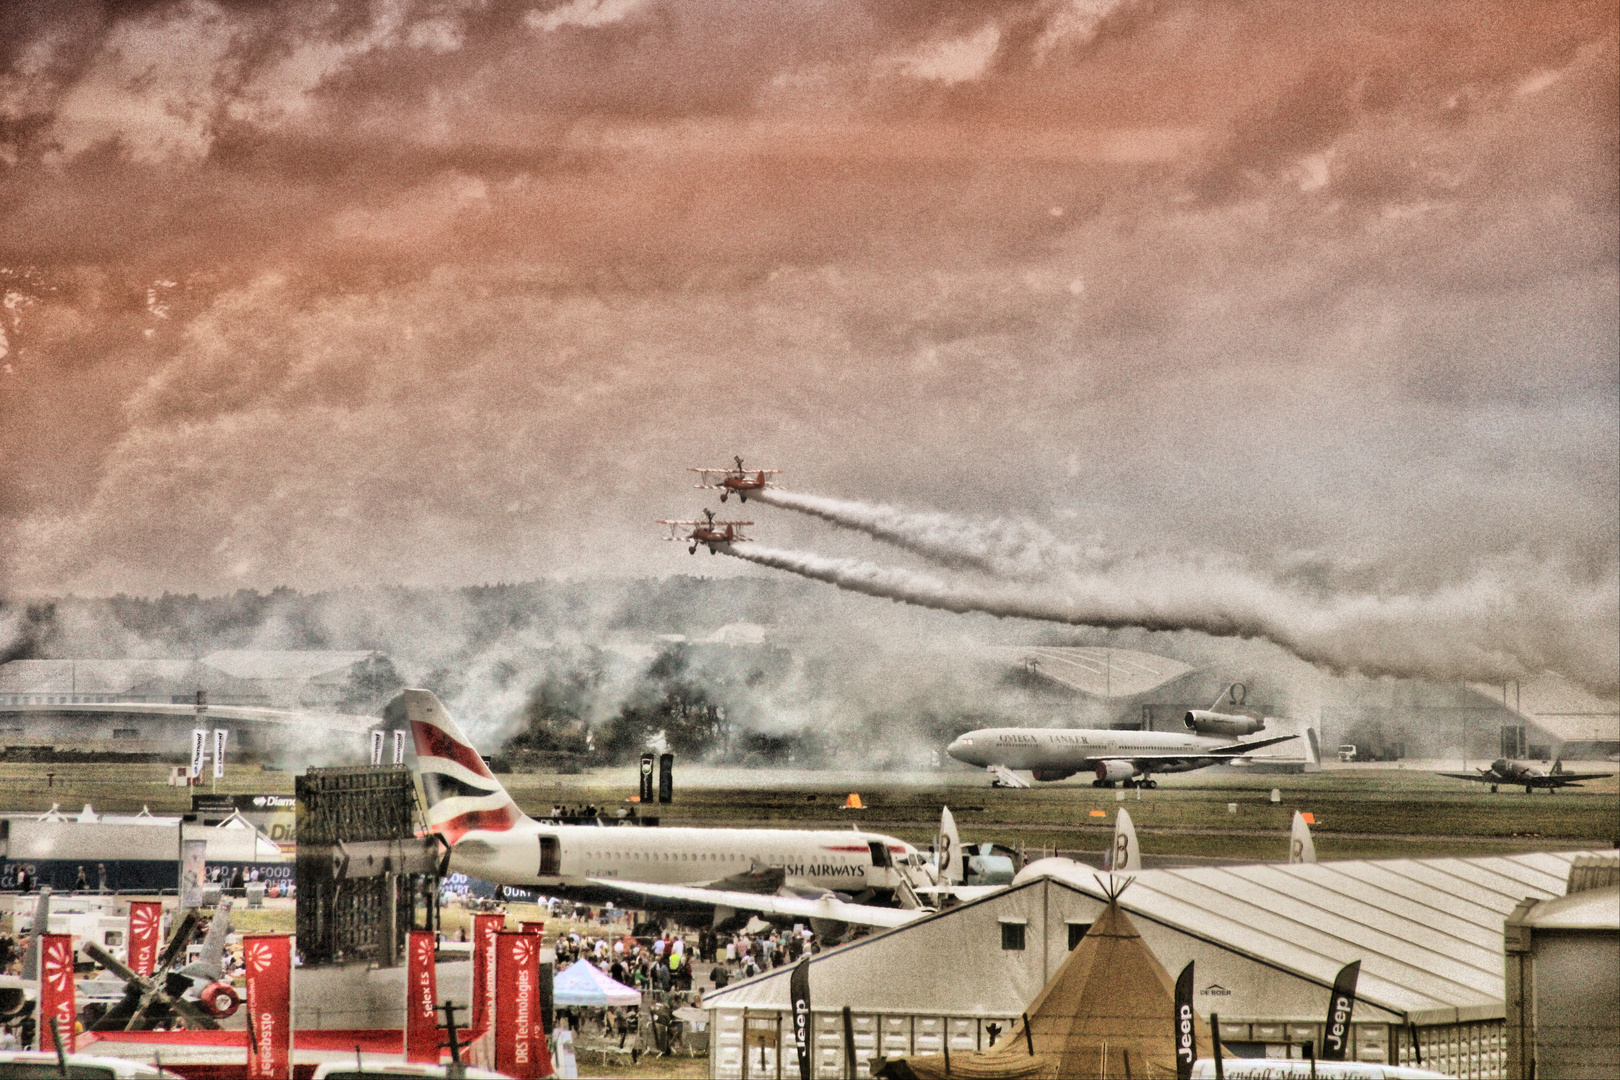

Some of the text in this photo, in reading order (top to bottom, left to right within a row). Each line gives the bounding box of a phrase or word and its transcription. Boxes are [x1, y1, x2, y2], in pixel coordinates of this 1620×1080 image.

[999, 734, 1089, 744] OMEGA TANKER
[260, 866, 290, 877] FOOD
[808, 864, 865, 877] AIRWAYS
[1117, 833, 1128, 870] B
[420, 972, 434, 1018] Selex ES
[515, 969, 531, 1063] DRS Technologies
[796, 999, 809, 1057] Jeep
[1178, 1004, 1192, 1063] Jeep
[1327, 996, 1351, 1051] Jeep
